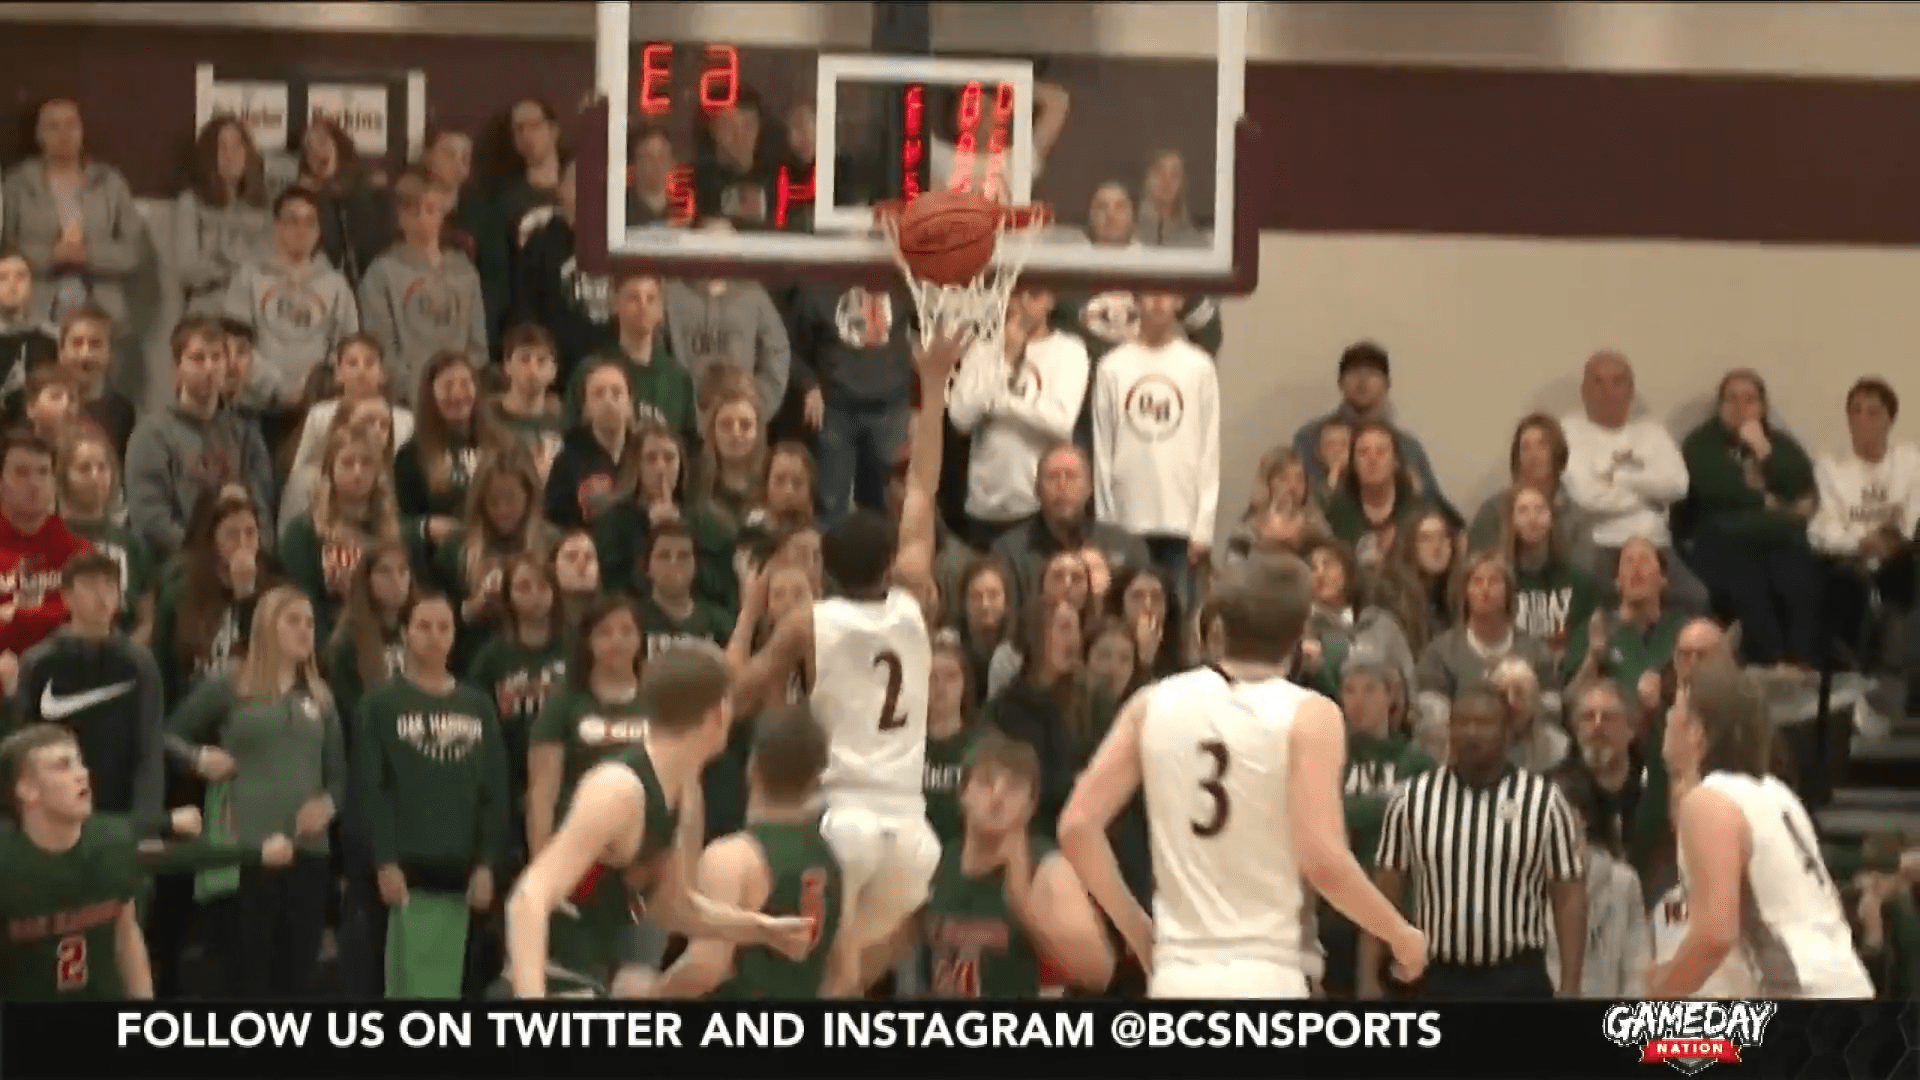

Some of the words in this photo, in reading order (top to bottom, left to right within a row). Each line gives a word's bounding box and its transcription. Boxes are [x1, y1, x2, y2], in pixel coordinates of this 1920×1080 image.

[873, 650, 909, 732] 2
[1189, 740, 1231, 840] 3
[56, 936, 88, 991] 2
